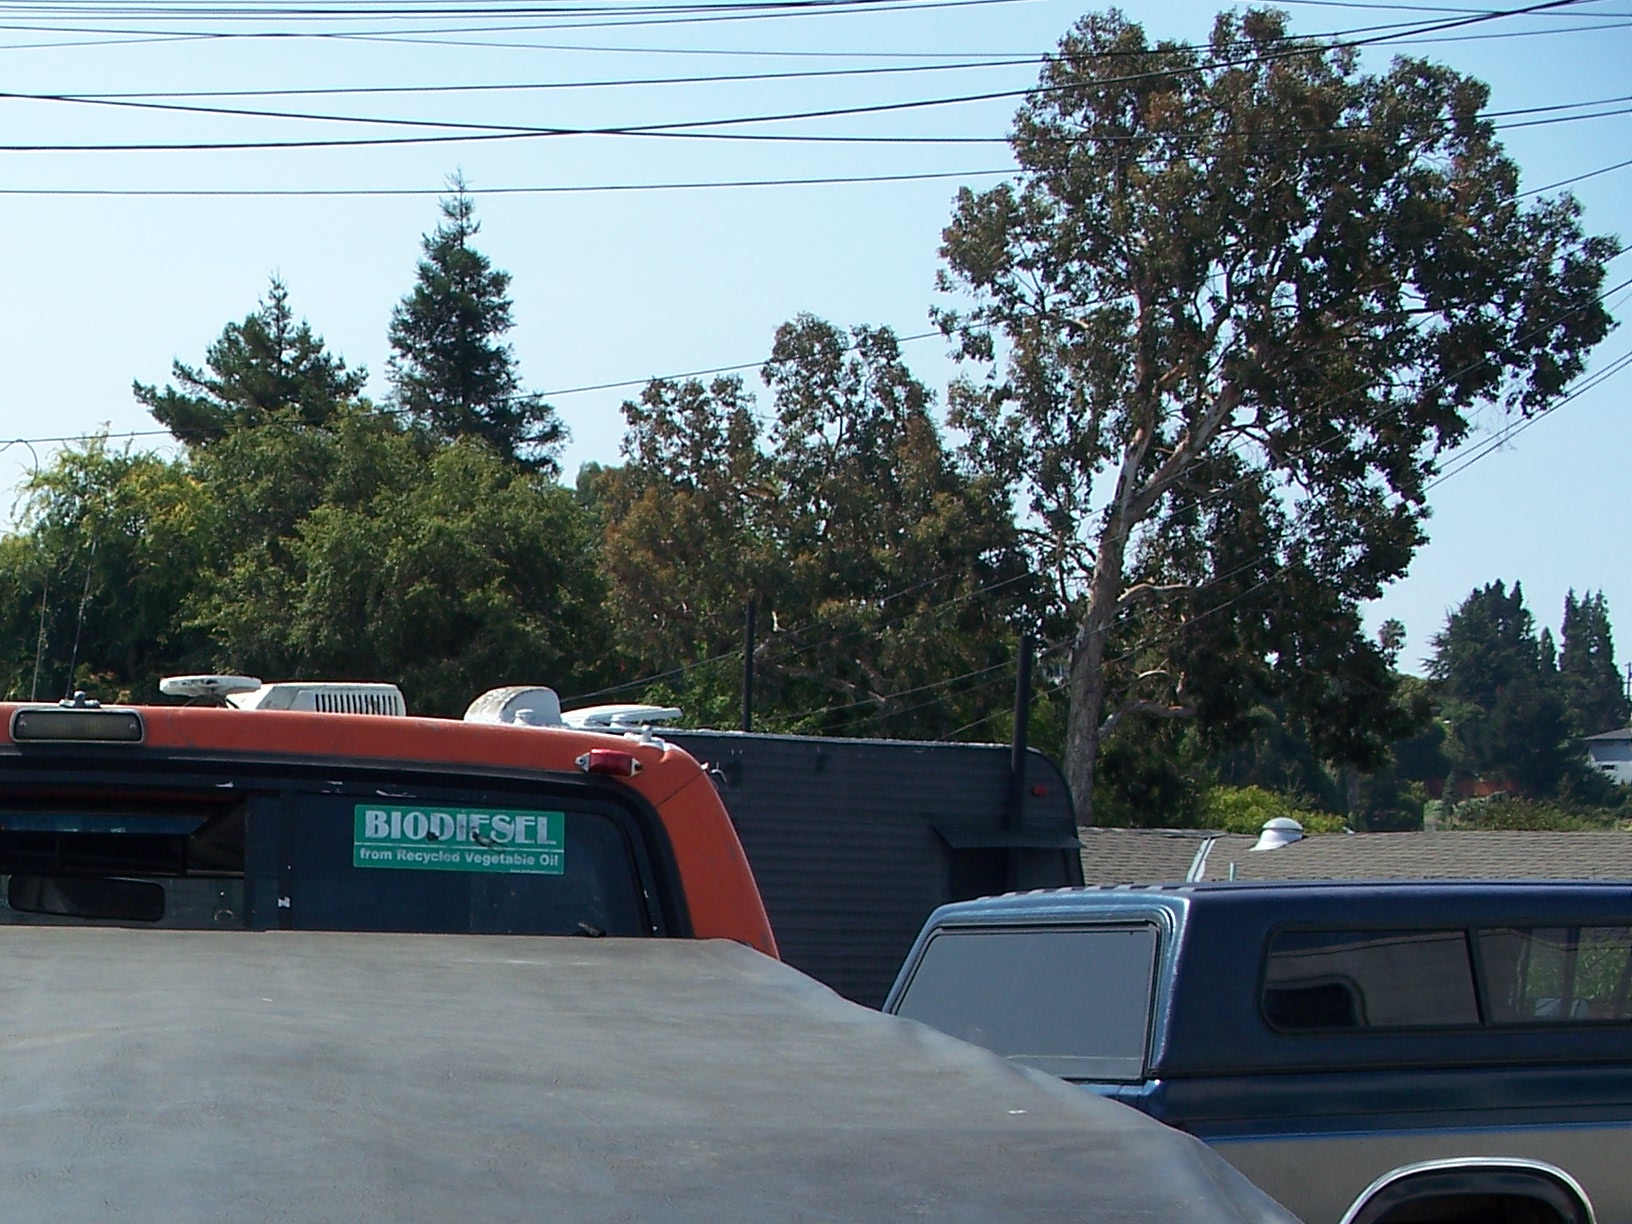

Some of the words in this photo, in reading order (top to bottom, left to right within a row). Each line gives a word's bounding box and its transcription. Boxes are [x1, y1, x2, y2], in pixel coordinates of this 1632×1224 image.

[365, 810, 557, 845] BIODIESEL
[360, 848, 392, 860] from
[397, 848, 460, 864] Recycled
[465, 852, 535, 866] Vegetable
[539, 854, 559, 867] Oil
